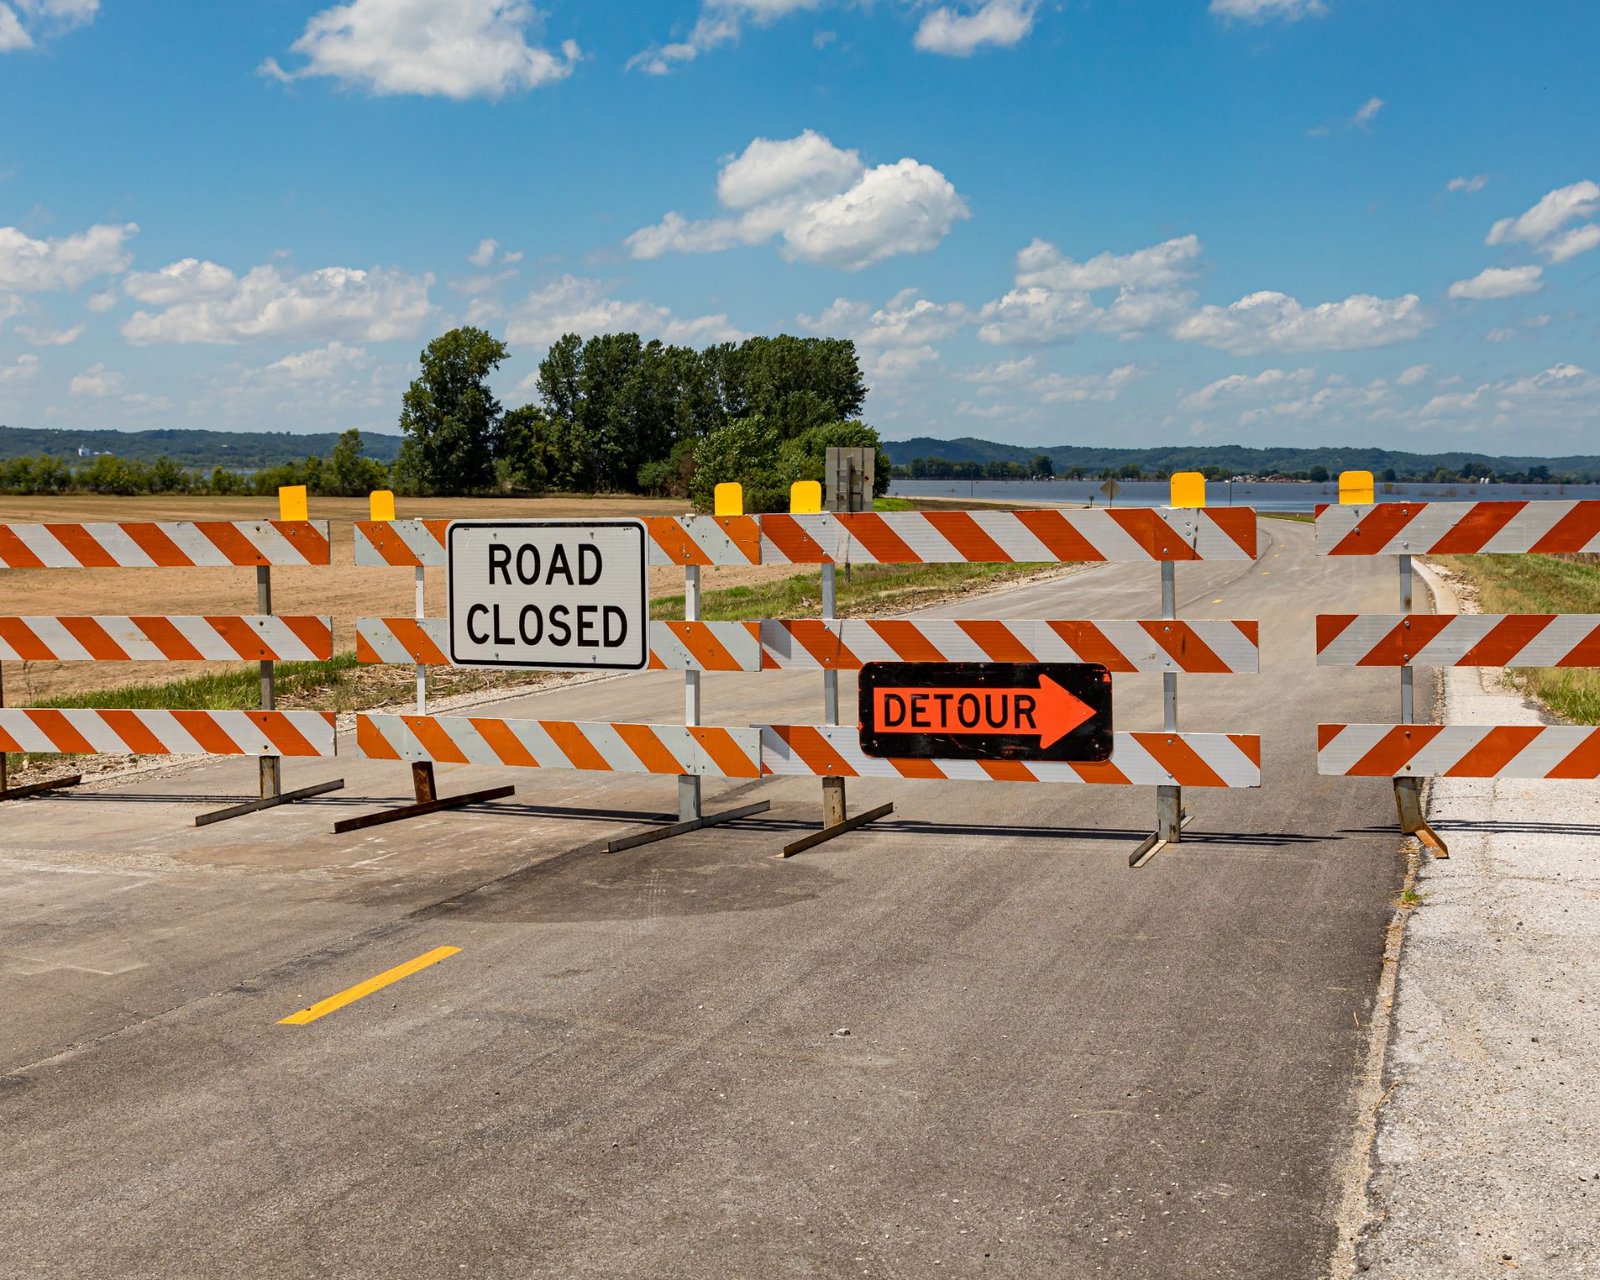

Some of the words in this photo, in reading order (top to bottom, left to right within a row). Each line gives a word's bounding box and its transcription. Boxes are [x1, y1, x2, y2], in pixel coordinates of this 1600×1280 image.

[488, 543, 603, 586] ROAD
[466, 603, 628, 648] CLOSED
[884, 693, 1038, 729] DETOUR
